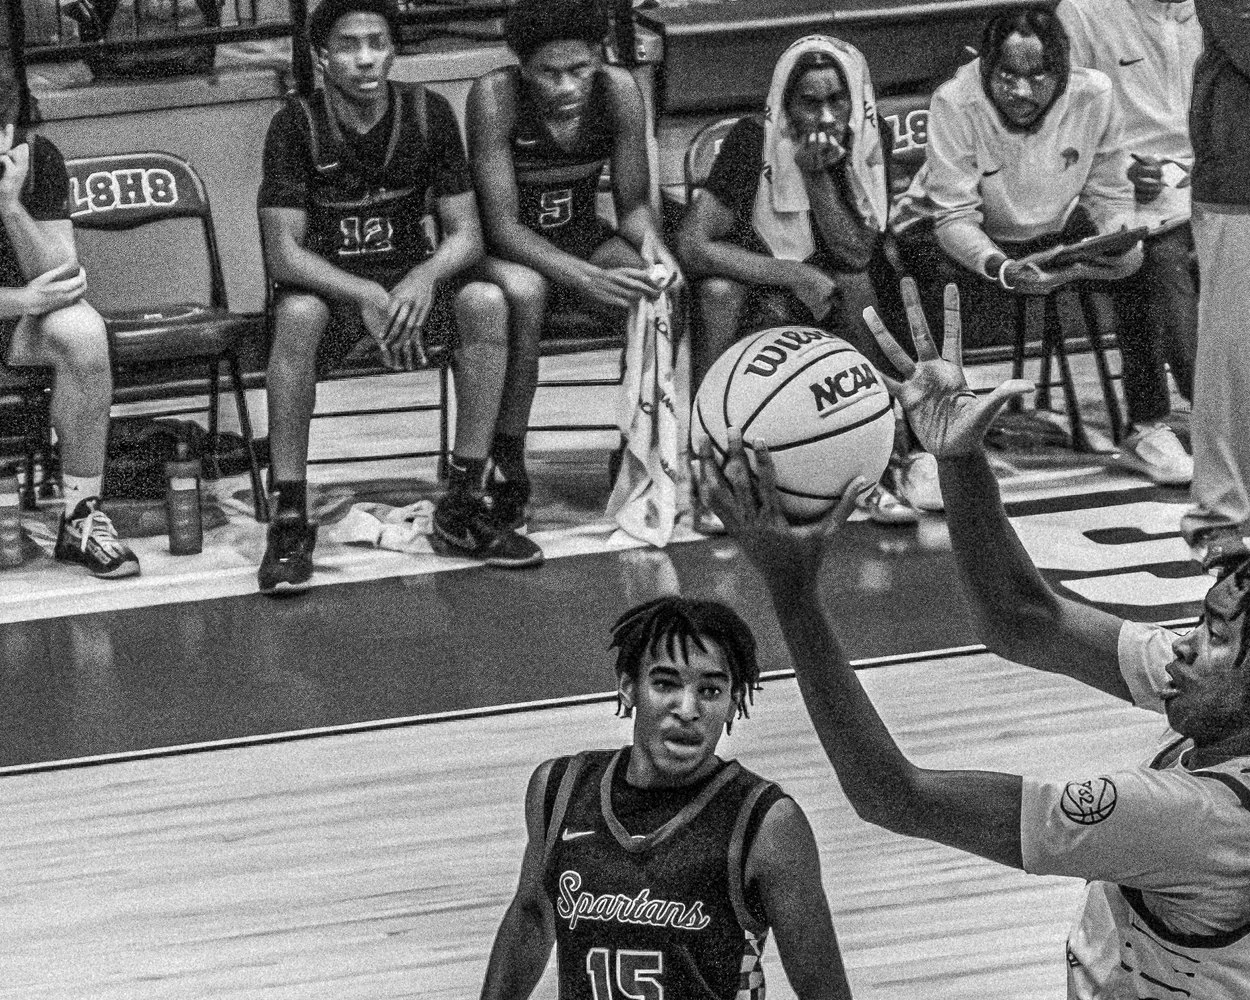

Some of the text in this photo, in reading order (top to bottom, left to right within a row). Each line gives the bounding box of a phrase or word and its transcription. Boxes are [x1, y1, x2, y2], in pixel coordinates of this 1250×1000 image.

[540, 188, 572, 228] 5
[809, 362, 878, 412] NCAA
[556, 870, 711, 930] Spartans
